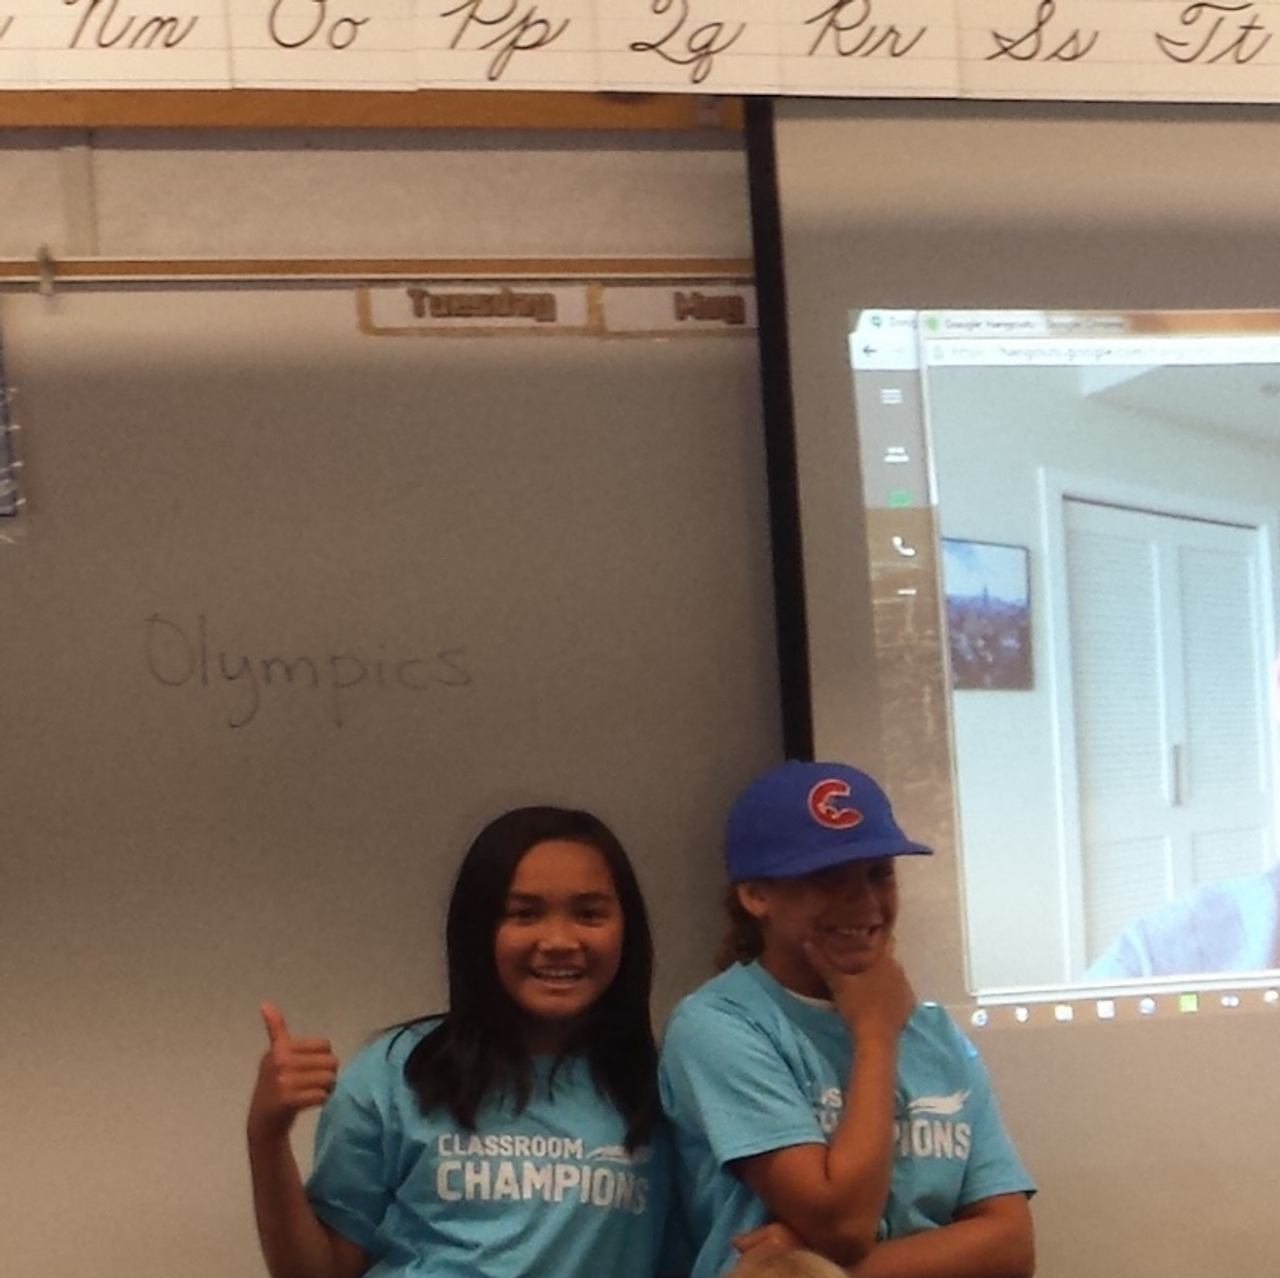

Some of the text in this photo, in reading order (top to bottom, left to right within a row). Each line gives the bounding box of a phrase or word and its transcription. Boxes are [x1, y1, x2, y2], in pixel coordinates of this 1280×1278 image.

[985, 0, 1100, 62] Ss
[1154, 2, 1273, 64] Tt
[144, 611, 473, 730] Olympics
[437, 1133, 584, 1160] CLASSROOM
[435, 1160, 650, 1216] CHAMPIONS
